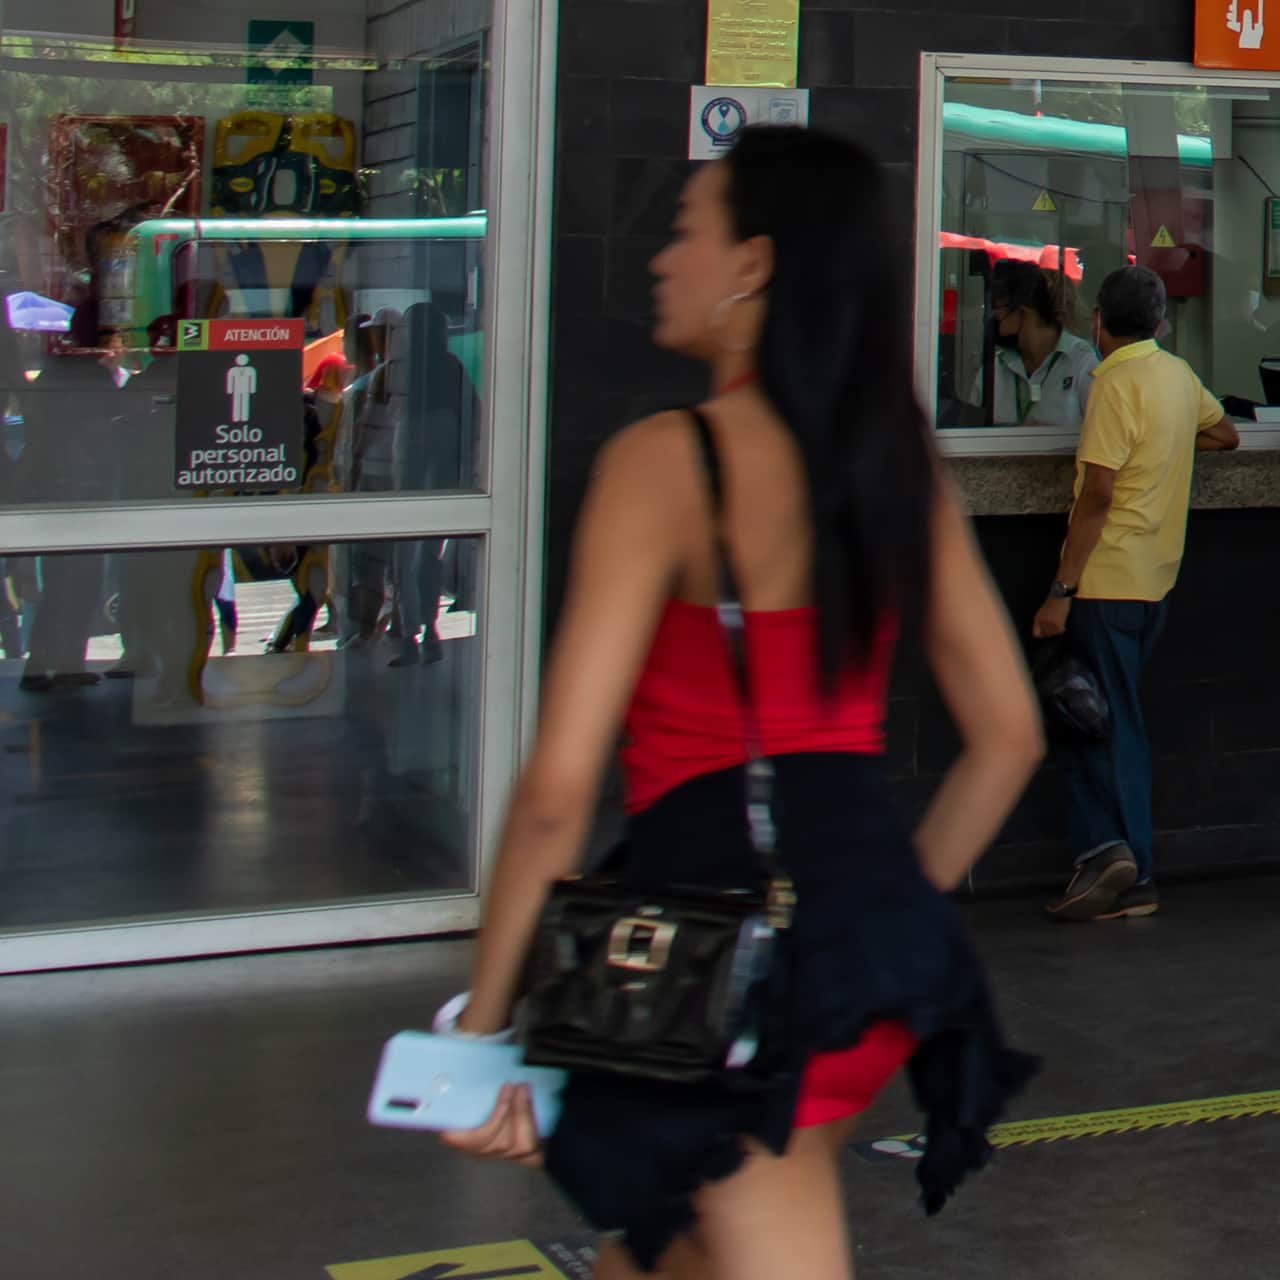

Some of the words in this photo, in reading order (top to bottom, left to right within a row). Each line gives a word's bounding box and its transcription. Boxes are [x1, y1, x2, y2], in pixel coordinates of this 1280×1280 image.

[224, 326, 290, 342] ATENCIÓN
[215, 424, 263, 443] Solo
[191, 443, 286, 469] personal
[178, 463, 297, 485] autorizado
